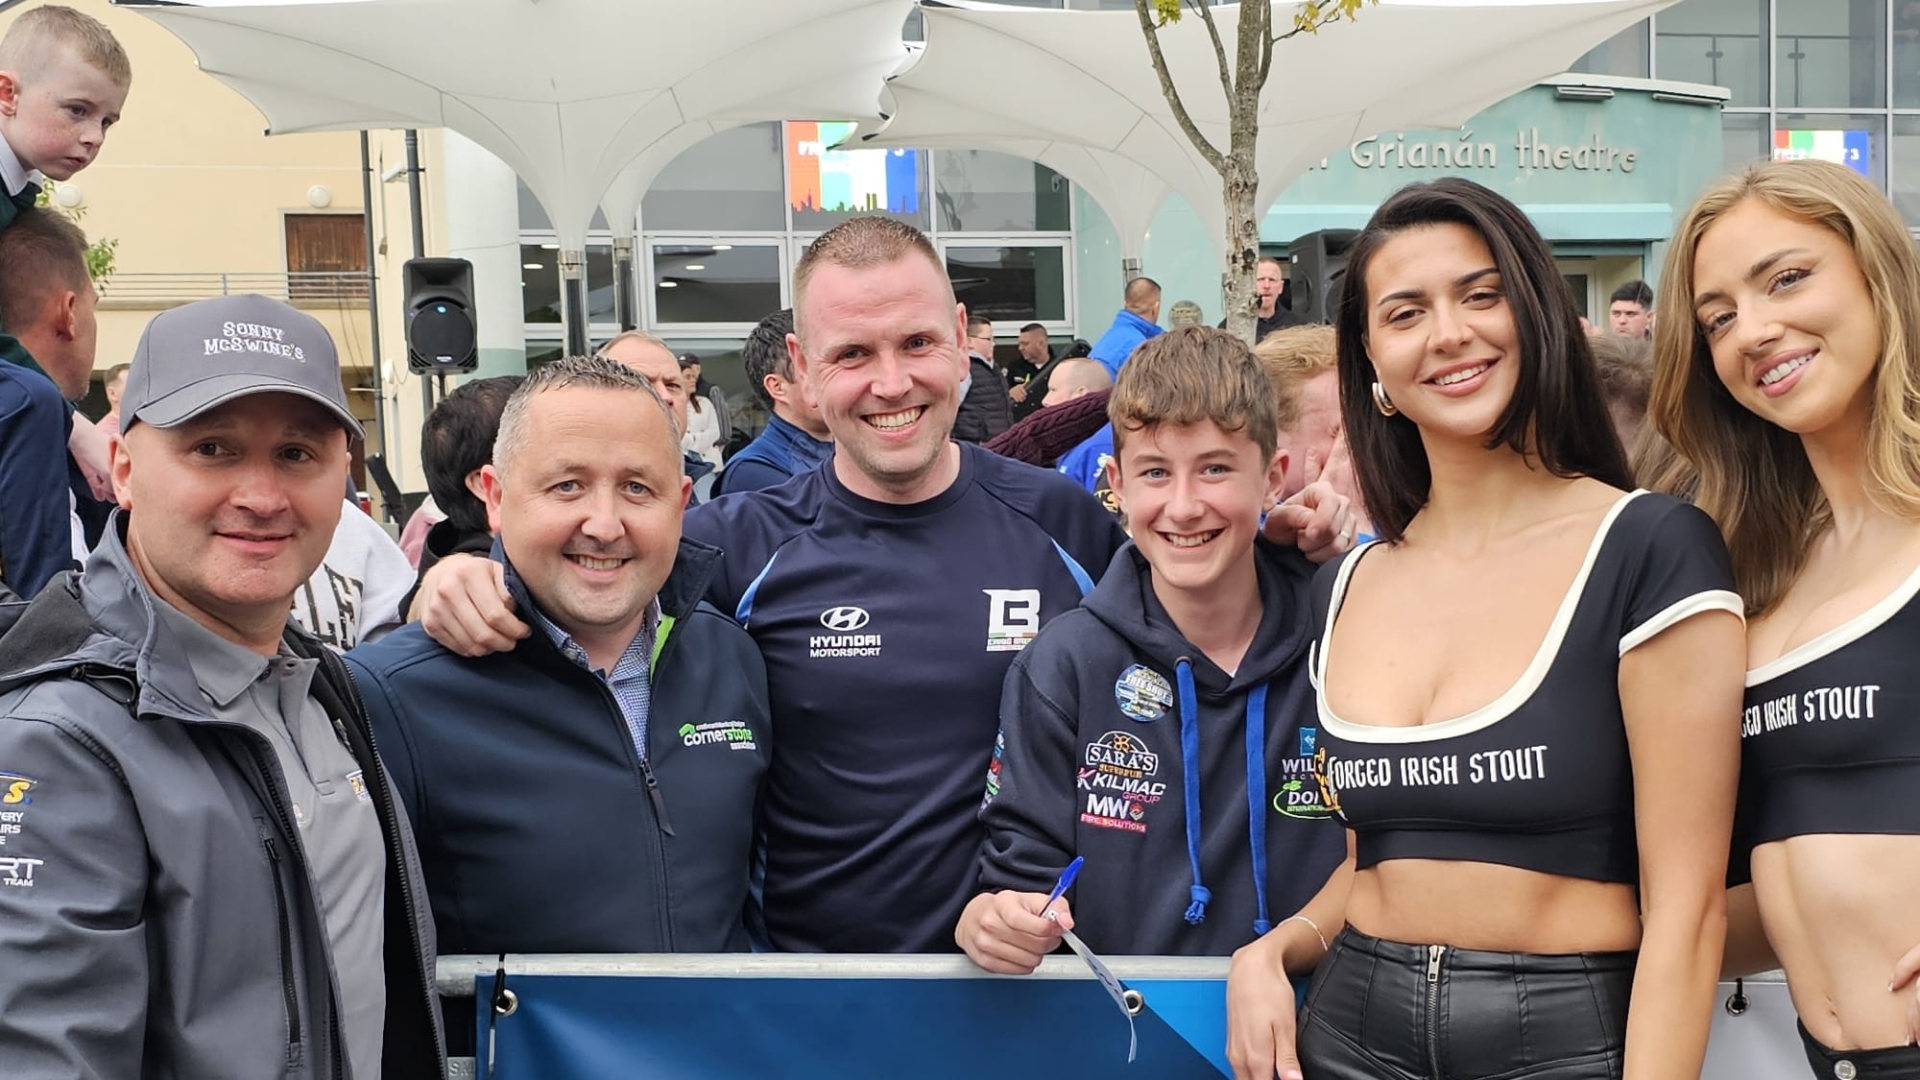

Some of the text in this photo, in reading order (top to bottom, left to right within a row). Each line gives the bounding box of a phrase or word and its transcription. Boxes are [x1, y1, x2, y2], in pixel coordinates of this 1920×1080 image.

[1350, 130, 1497, 169] Grianán
[1514, 127, 1636, 173] theatre
[222, 321, 284, 341] SONNY
[810, 635, 882, 648] HYUNDAI
[810, 647, 882, 658] MOTORSPORT
[1763, 693, 1798, 732] IRISH
[1803, 685, 1880, 722] STOUT
[684, 727, 753, 747] cornerstone
[1089, 746, 1154, 771] SARA'S
[1282, 759, 1315, 773] WIL
[1328, 746, 1548, 800] FORGED IRISH STOUT
[1092, 772, 1167, 796] KILMAC
[1086, 793, 1131, 820] MW
[1122, 791, 1161, 804] GROUP
[0, 824, 22, 834] IRS
[1102, 817, 1147, 833] SOLUTIONS
[3, 877, 33, 887] TEAM
